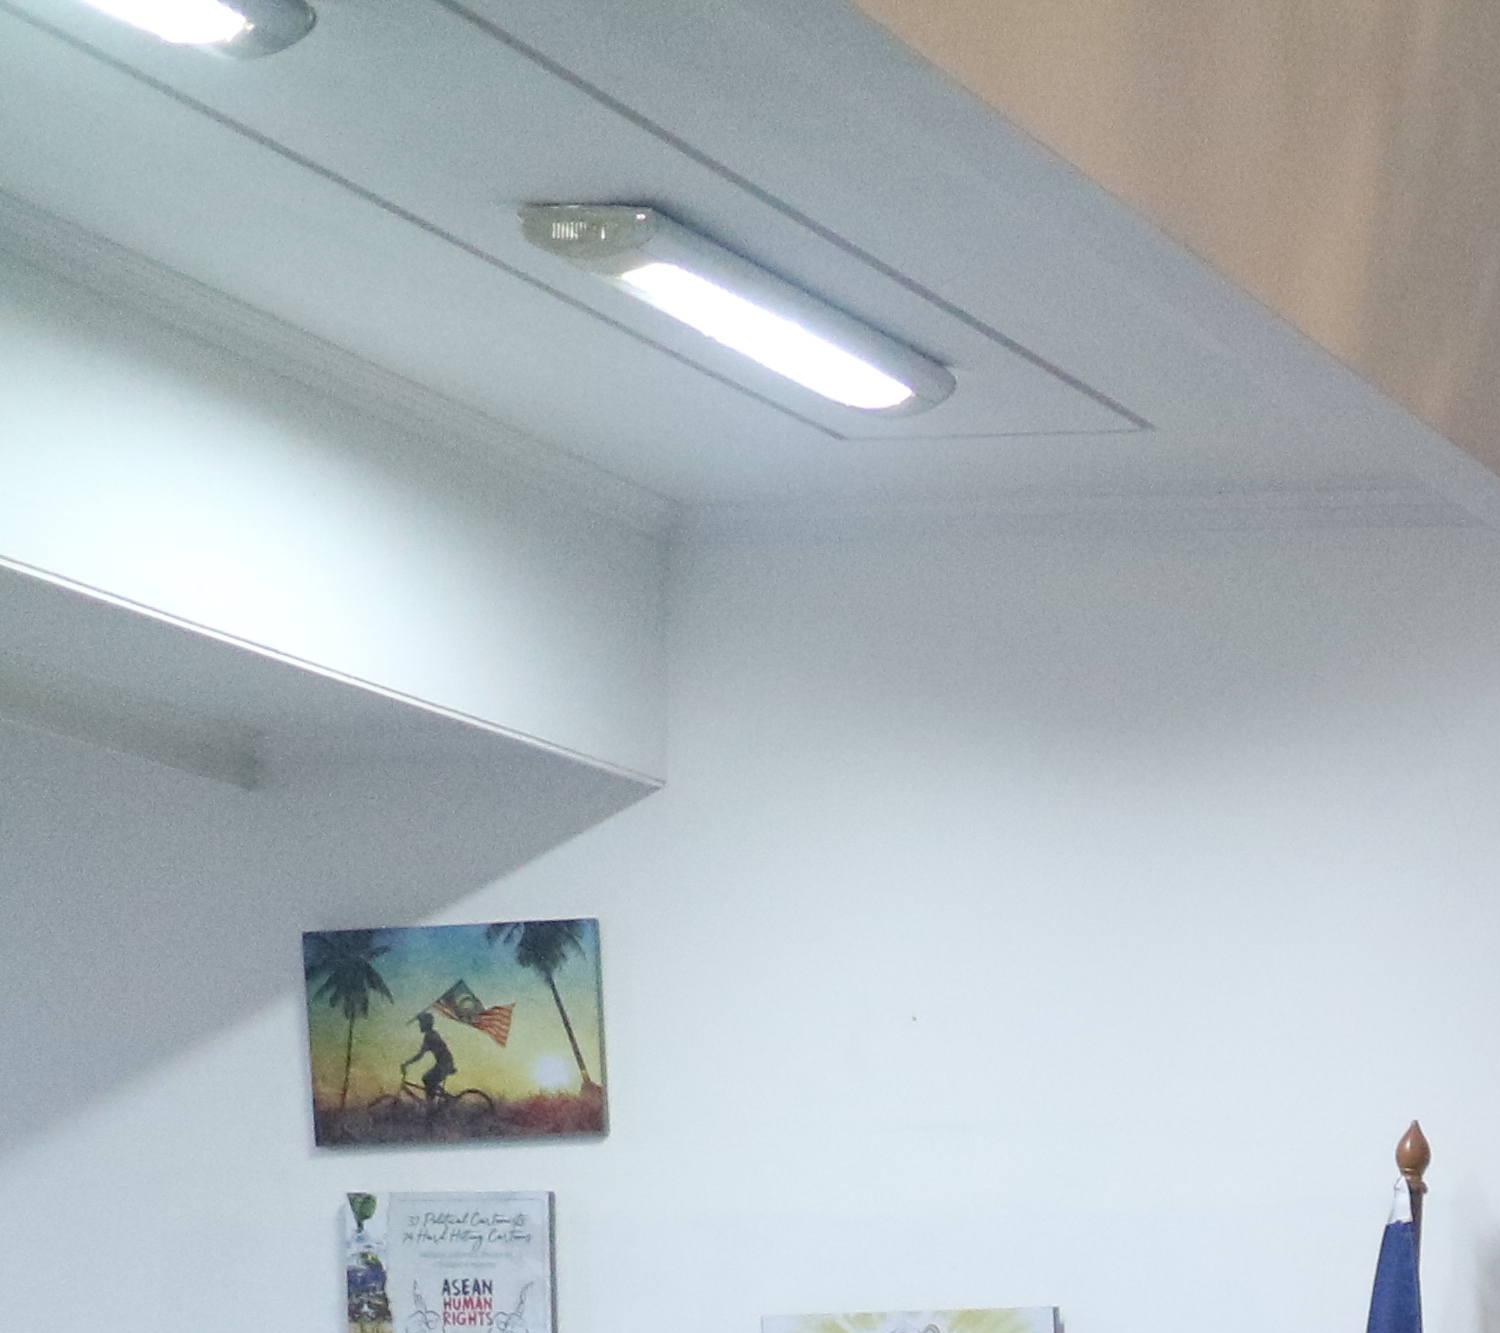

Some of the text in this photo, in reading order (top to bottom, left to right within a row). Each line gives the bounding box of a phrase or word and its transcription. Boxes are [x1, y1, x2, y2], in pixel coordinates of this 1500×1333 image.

[442, 1278, 493, 1296] ASEAN
[443, 1297, 493, 1311] HUMAN
[443, 1311, 494, 1326] RIGHTS
